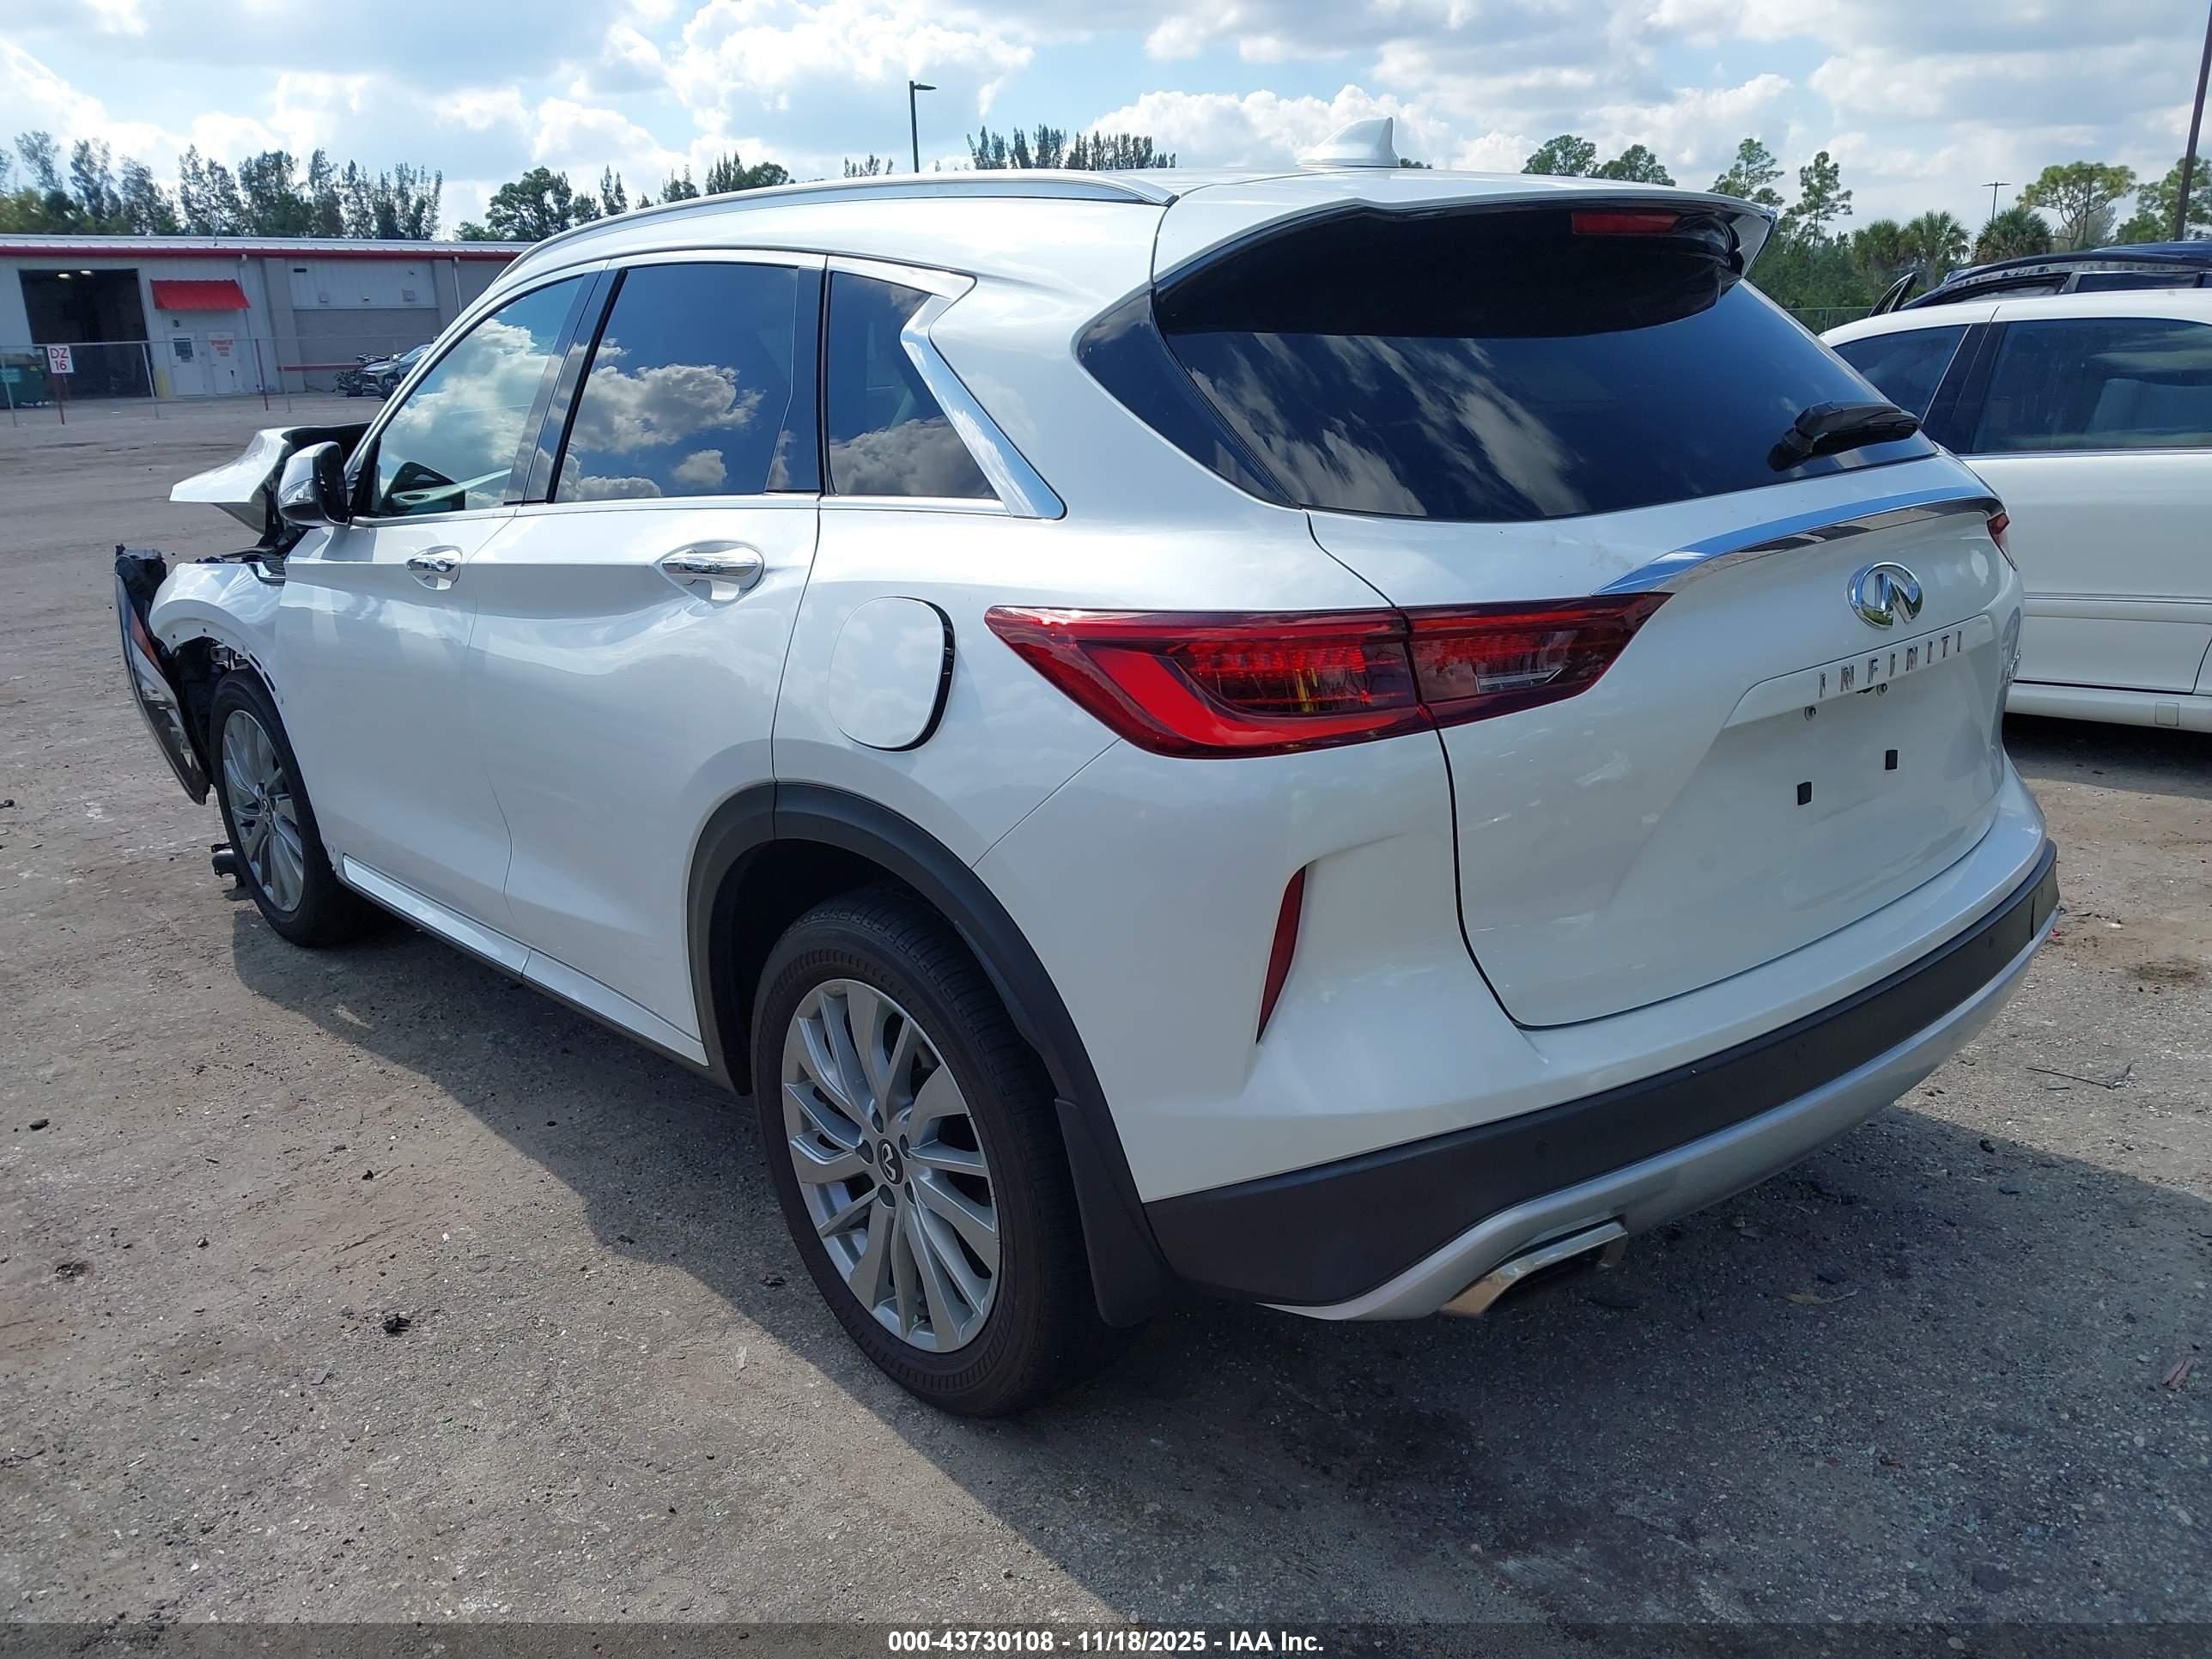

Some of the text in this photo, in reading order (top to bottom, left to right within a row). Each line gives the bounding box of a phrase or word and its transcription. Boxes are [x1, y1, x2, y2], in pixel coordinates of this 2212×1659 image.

[49, 348, 69, 359] DZ
[54, 360, 67, 371] 16
[1818, 630, 1964, 699] INFINITI
